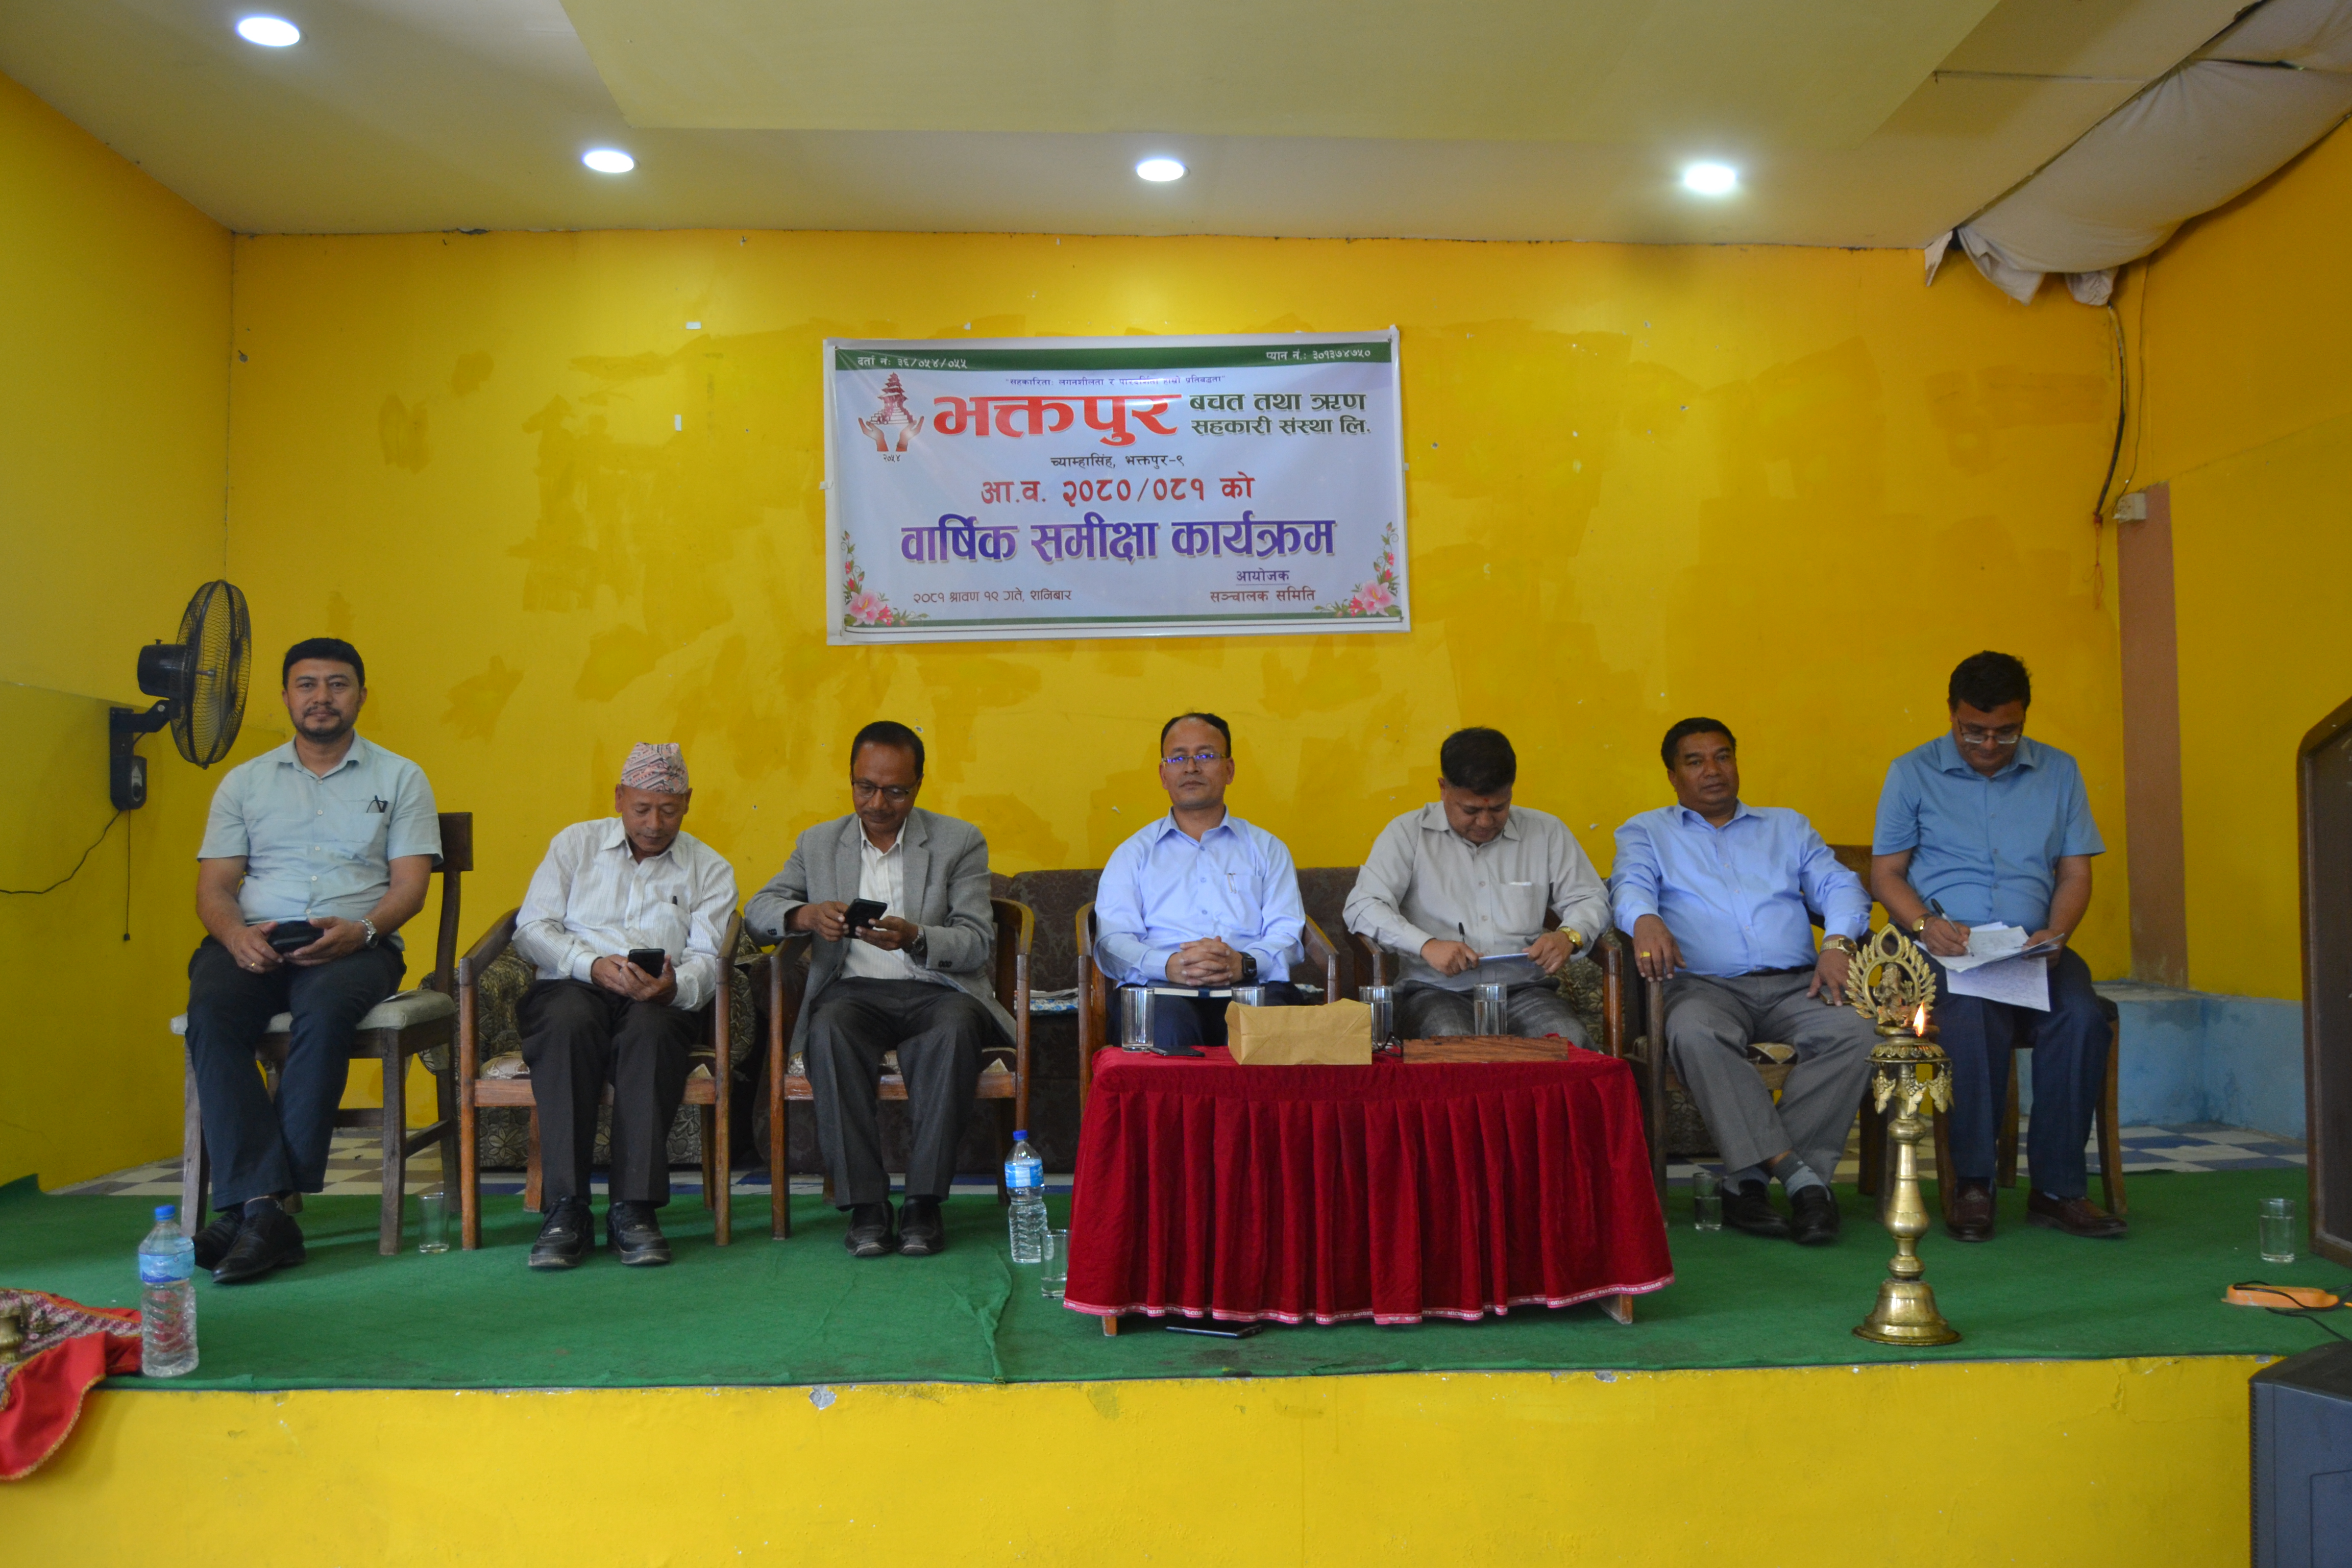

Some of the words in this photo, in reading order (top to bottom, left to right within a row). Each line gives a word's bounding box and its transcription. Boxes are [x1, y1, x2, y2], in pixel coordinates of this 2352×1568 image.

[1266, 351, 1288, 360] प्यान
[1313, 350, 1371, 360] ३०१३७४७५०
[1059, 377, 1104, 385] लगनशीलता
[1190, 394, 1246, 412] बचत
[1253, 394, 1303, 411] तथा
[1310, 394, 1367, 411] ऋण
[933, 395, 1182, 447] भक्तपुर
[1191, 415, 1272, 435] सहकारी
[1279, 417, 1333, 435] संस्था
[1339, 414, 1371, 435] लि.
[1125, 455, 1184, 469] भक्तपुर-९
[981, 481, 1046, 504] आ.व.
[1063, 478, 1205, 505] २०८०/०८१
[1219, 471, 1255, 499] को
[901, 513, 1018, 562] वार्षिक
[1030, 511, 1160, 563] समीक्षा
[1171, 510, 1337, 558] कार्यक्रम
[1236, 568, 1290, 582] आयोजक
[914, 593, 945, 603] २०८१
[949, 591, 980, 602] श्रावण
[984, 591, 998, 601] १९
[1003, 587, 1025, 602] गते,
[1030, 588, 1072, 601] शनिबार
[1210, 590, 1269, 602] सञ्चालक
[1276, 585, 1316, 601] समिति
